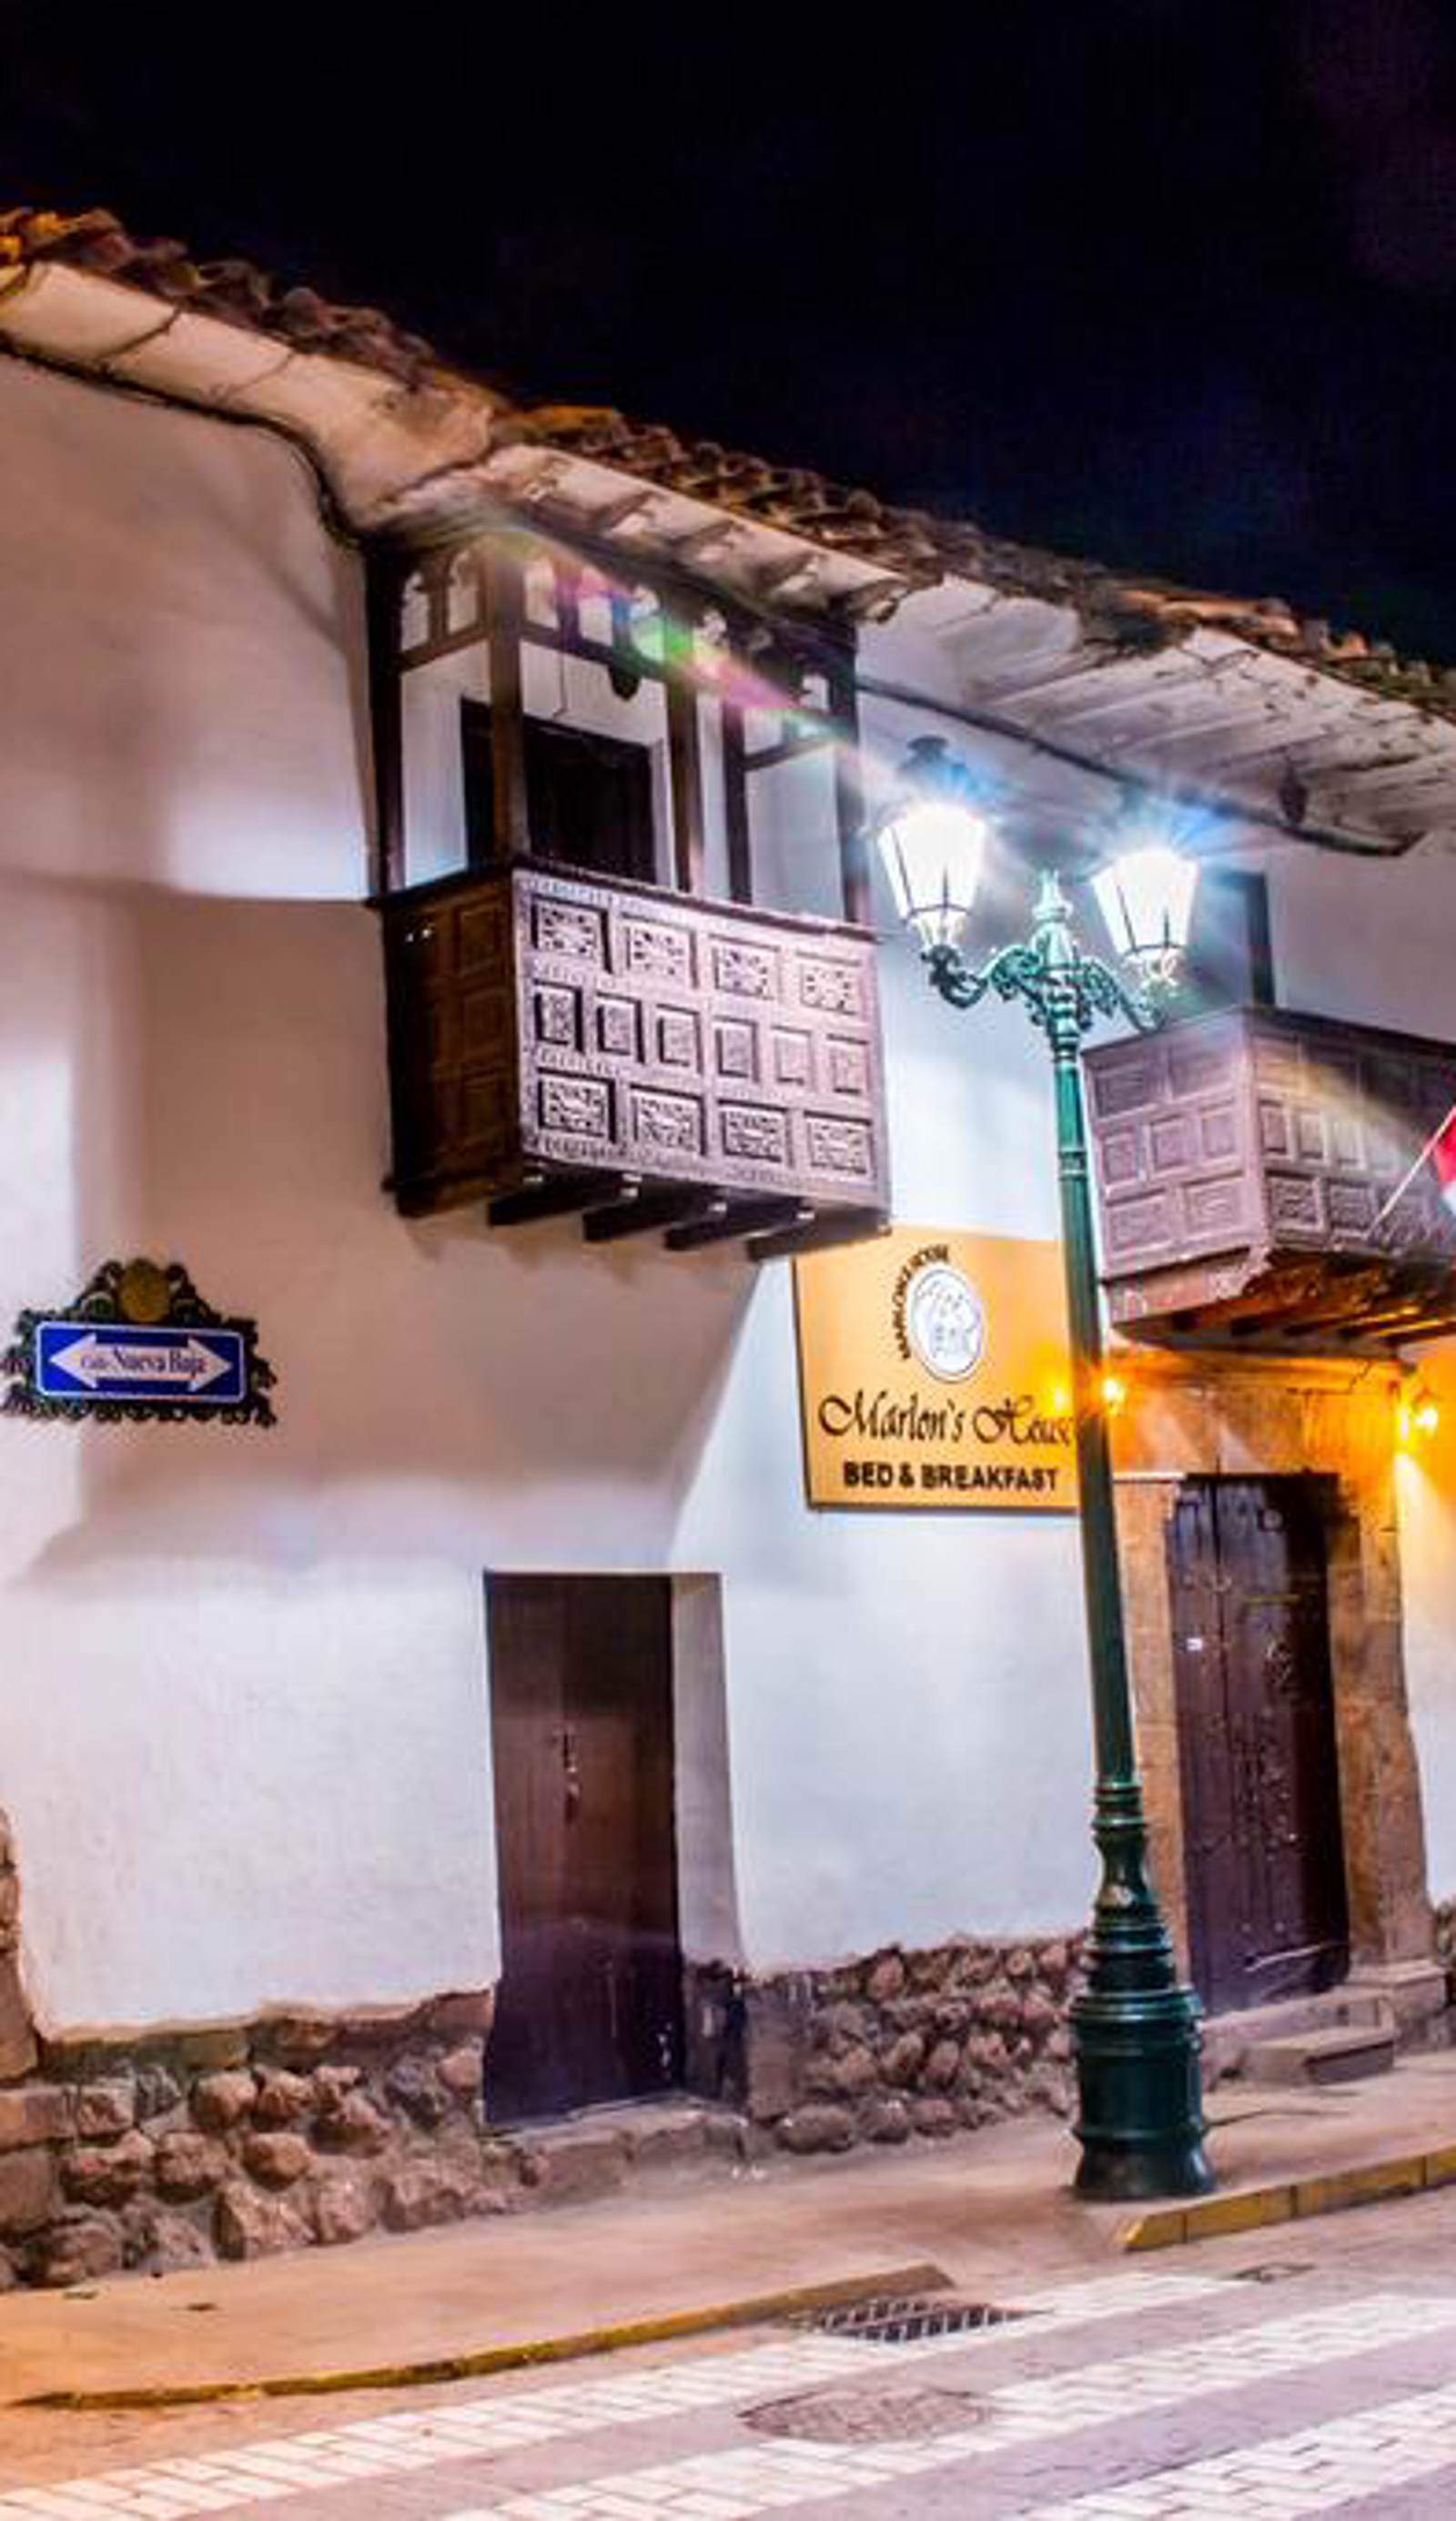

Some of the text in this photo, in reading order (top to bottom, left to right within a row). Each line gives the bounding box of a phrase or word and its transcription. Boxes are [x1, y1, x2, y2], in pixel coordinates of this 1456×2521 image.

[818, 1389, 1076, 1446] Marlon's Hous
[843, 1461, 1059, 1491] BED & BREAKFAST
